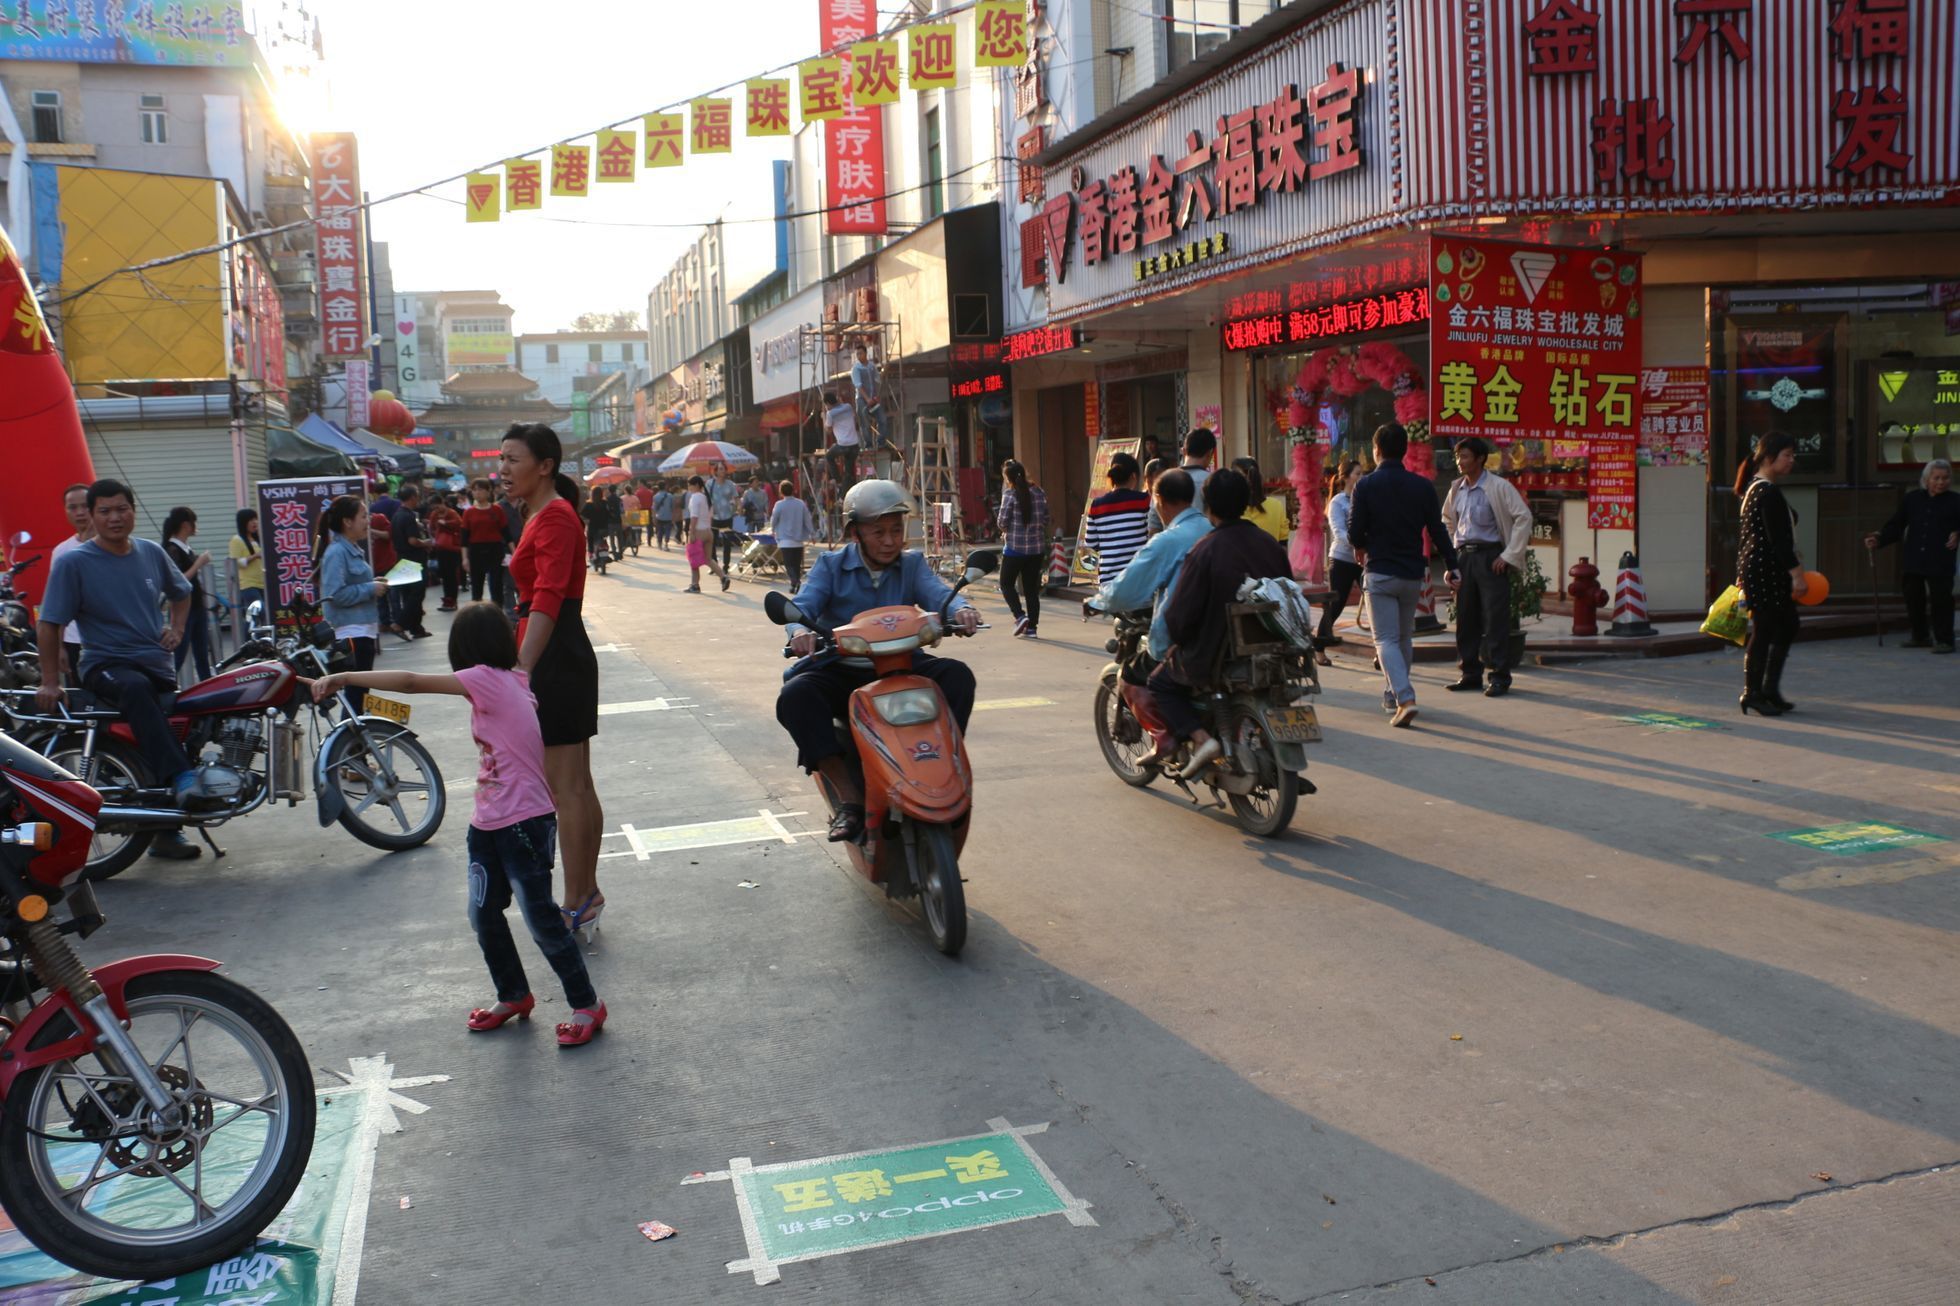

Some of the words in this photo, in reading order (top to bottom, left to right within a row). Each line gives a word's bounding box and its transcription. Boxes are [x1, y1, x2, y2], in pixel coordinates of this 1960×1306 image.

[1078, 62, 1364, 267] 香港金六福珠宝
[1591, 86, 1913, 184] 批发
[1448, 331, 1488, 343] JINLIUFU
[1492, 334, 1533, 347] JEWELRY
[1537, 338, 1599, 351] WOHOLESALE
[1603, 342, 1624, 352] CITY
[1449, 303, 1625, 337] 金六福珠宝批发城
[1480, 348, 1525, 361] 香港品牌
[1546, 352, 1590, 366] 国际品质
[1439, 362, 1523, 422] 黄金
[1549, 368, 1636, 427] 钻石
[772, 1149, 1009, 1213] 买一送五
